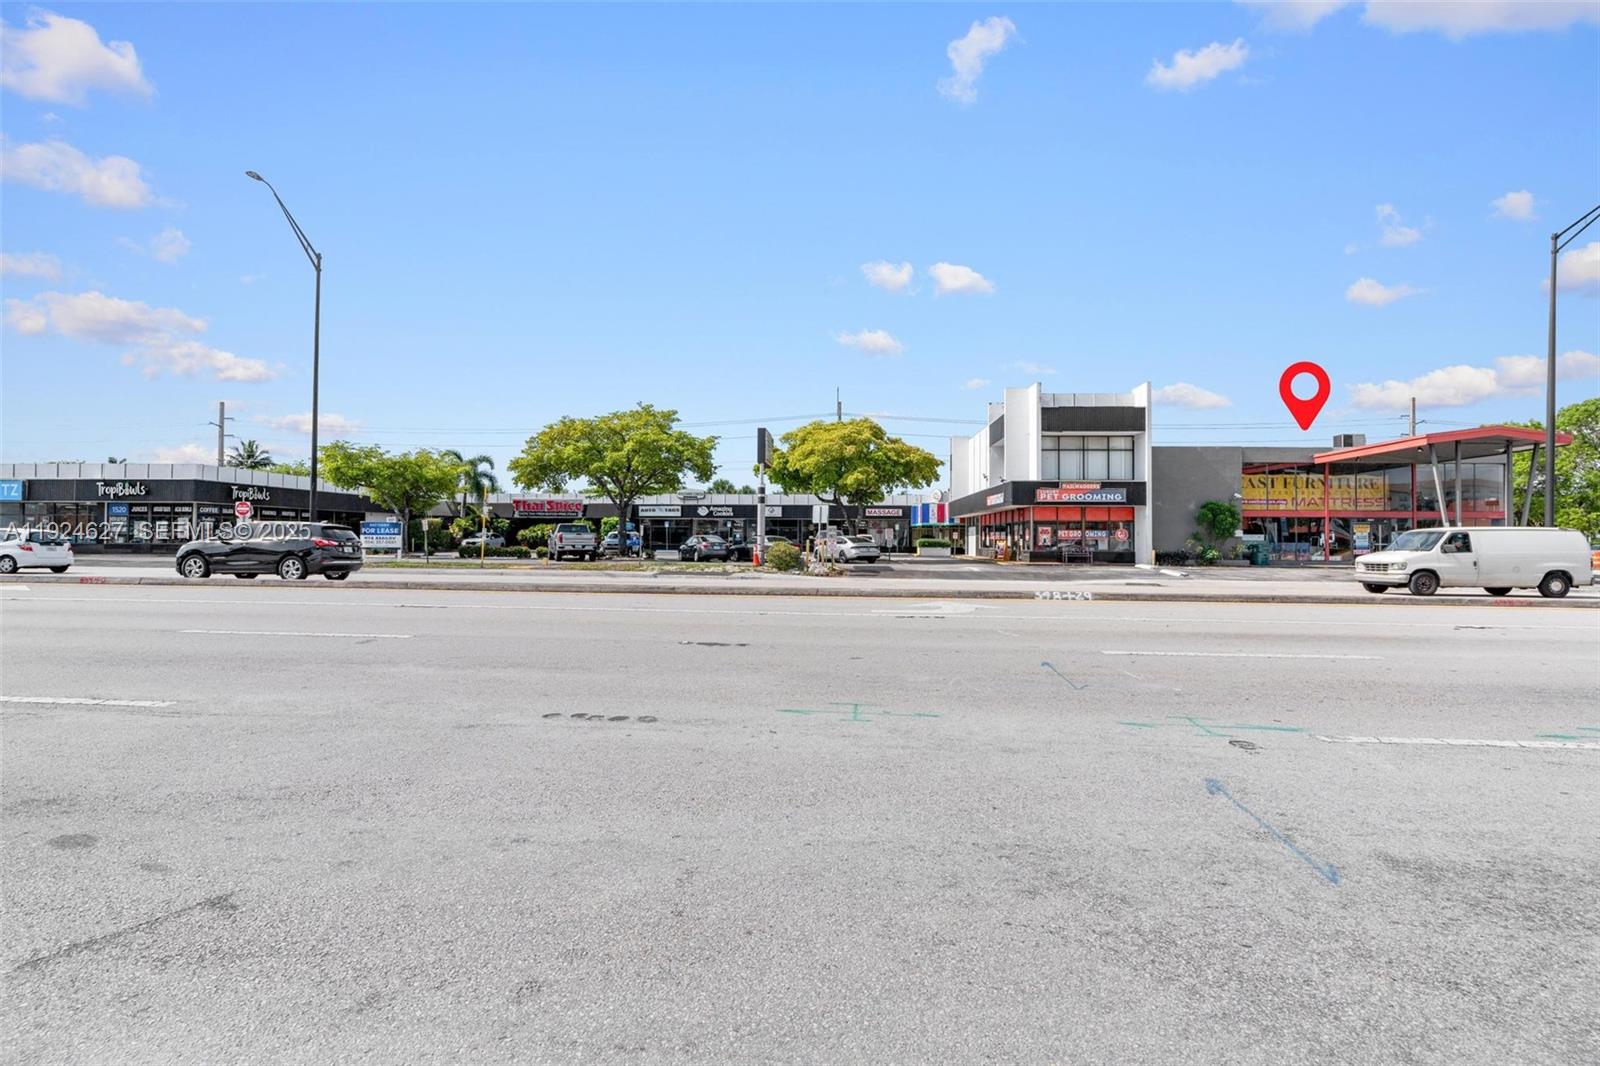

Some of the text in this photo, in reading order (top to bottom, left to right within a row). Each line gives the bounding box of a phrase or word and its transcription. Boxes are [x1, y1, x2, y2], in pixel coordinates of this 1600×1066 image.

[96, 481, 147, 499] TropiBowls
[231, 486, 270, 501] TropiBowls
[1062, 493, 1122, 501] GROOMING
[199, 506, 219, 514] COFFEE
